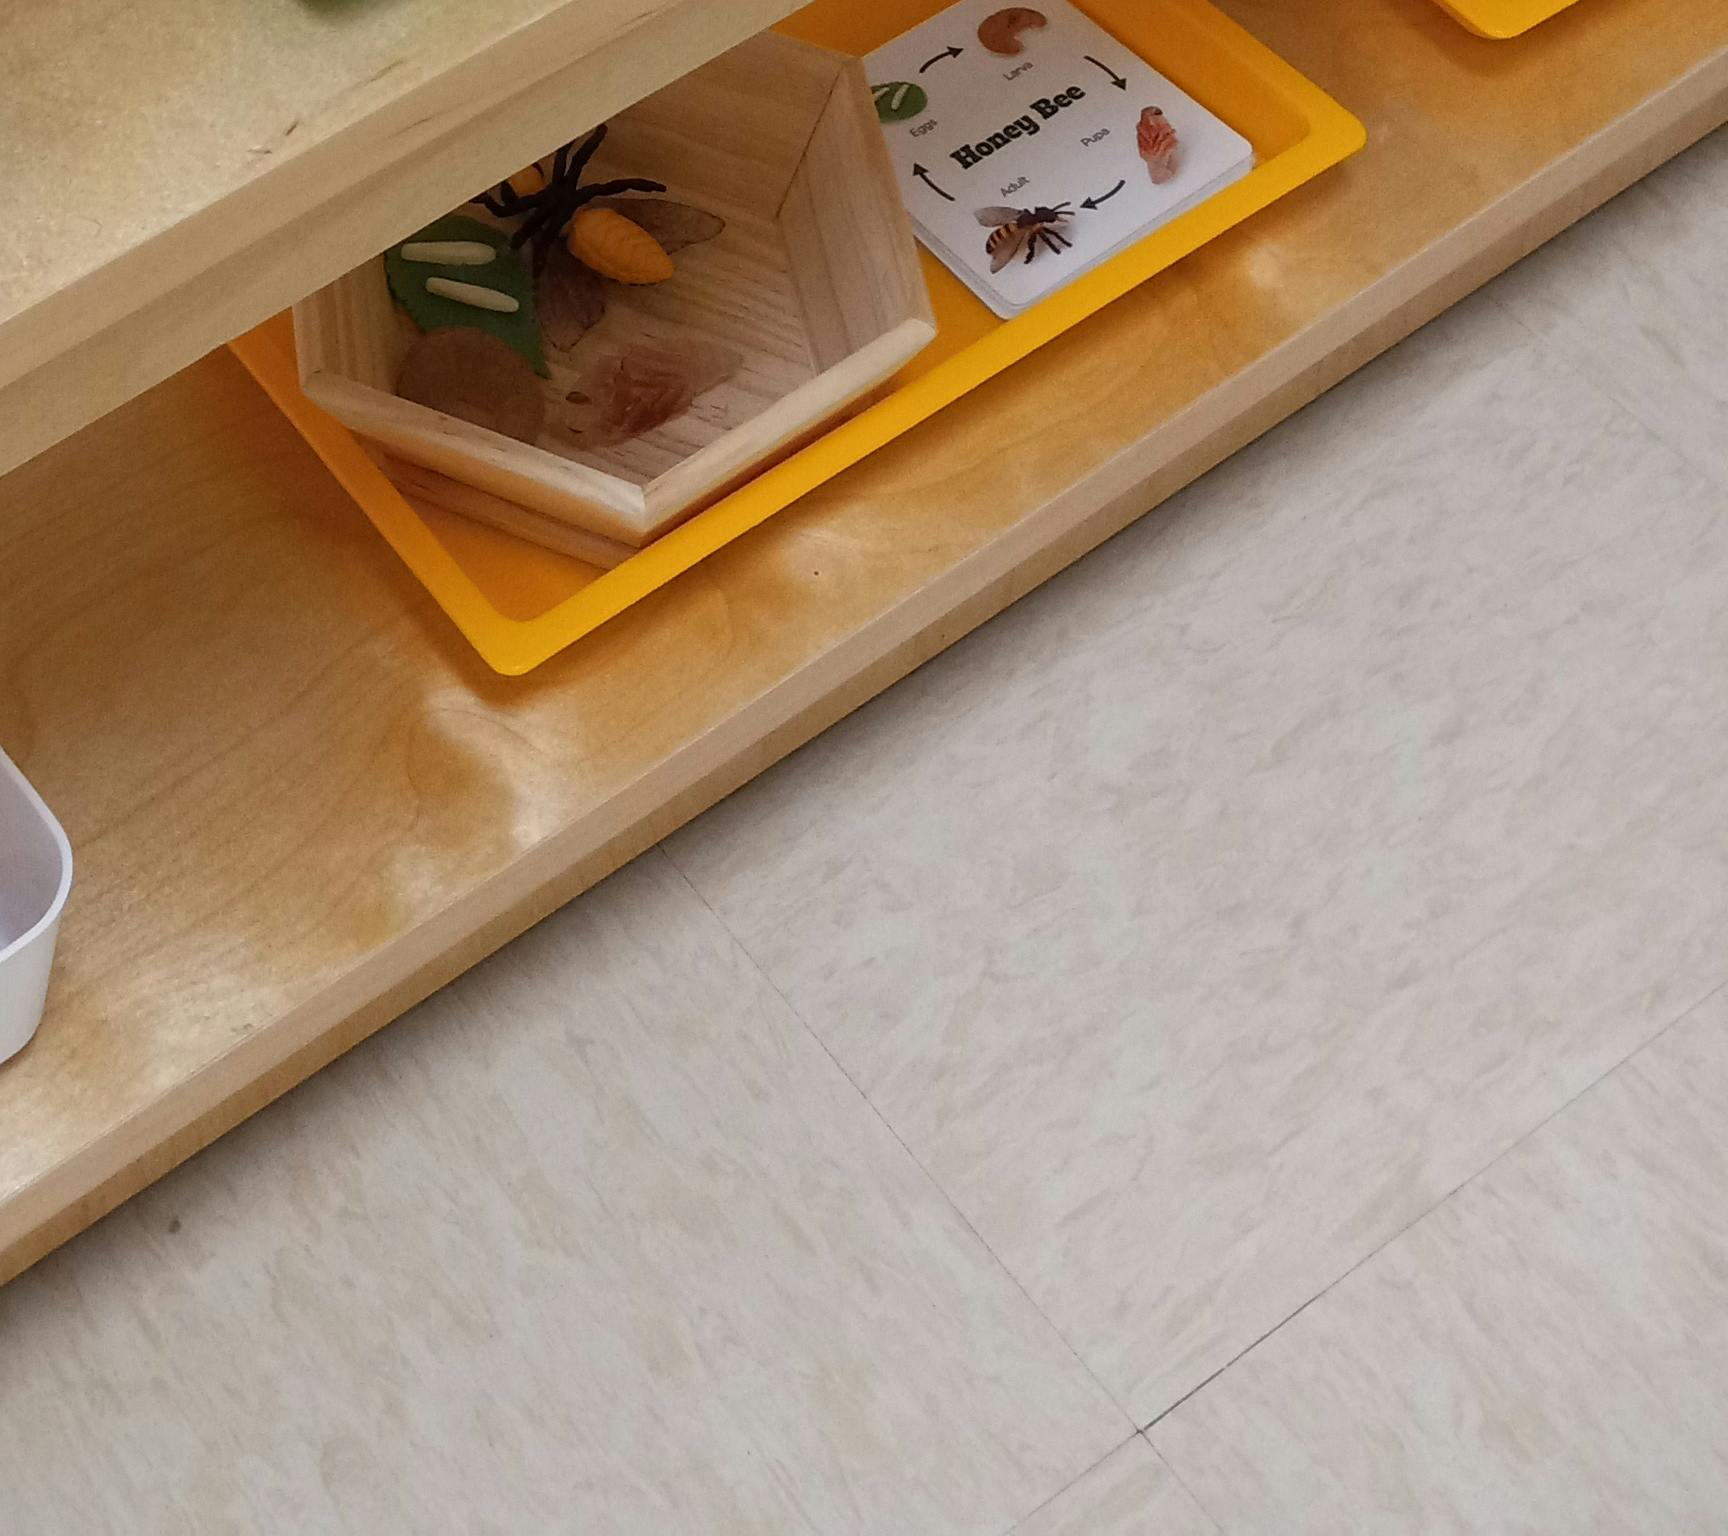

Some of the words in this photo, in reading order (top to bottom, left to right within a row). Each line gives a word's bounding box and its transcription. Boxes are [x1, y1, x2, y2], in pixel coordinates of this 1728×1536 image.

[1003, 62, 1034, 81] Larva
[909, 118, 939, 138] Eggs
[949, 114, 1041, 170] Honey
[1029, 85, 1086, 120] Bee
[1080, 128, 1111, 147] Pupa
[1000, 176, 1030, 197] Adult
